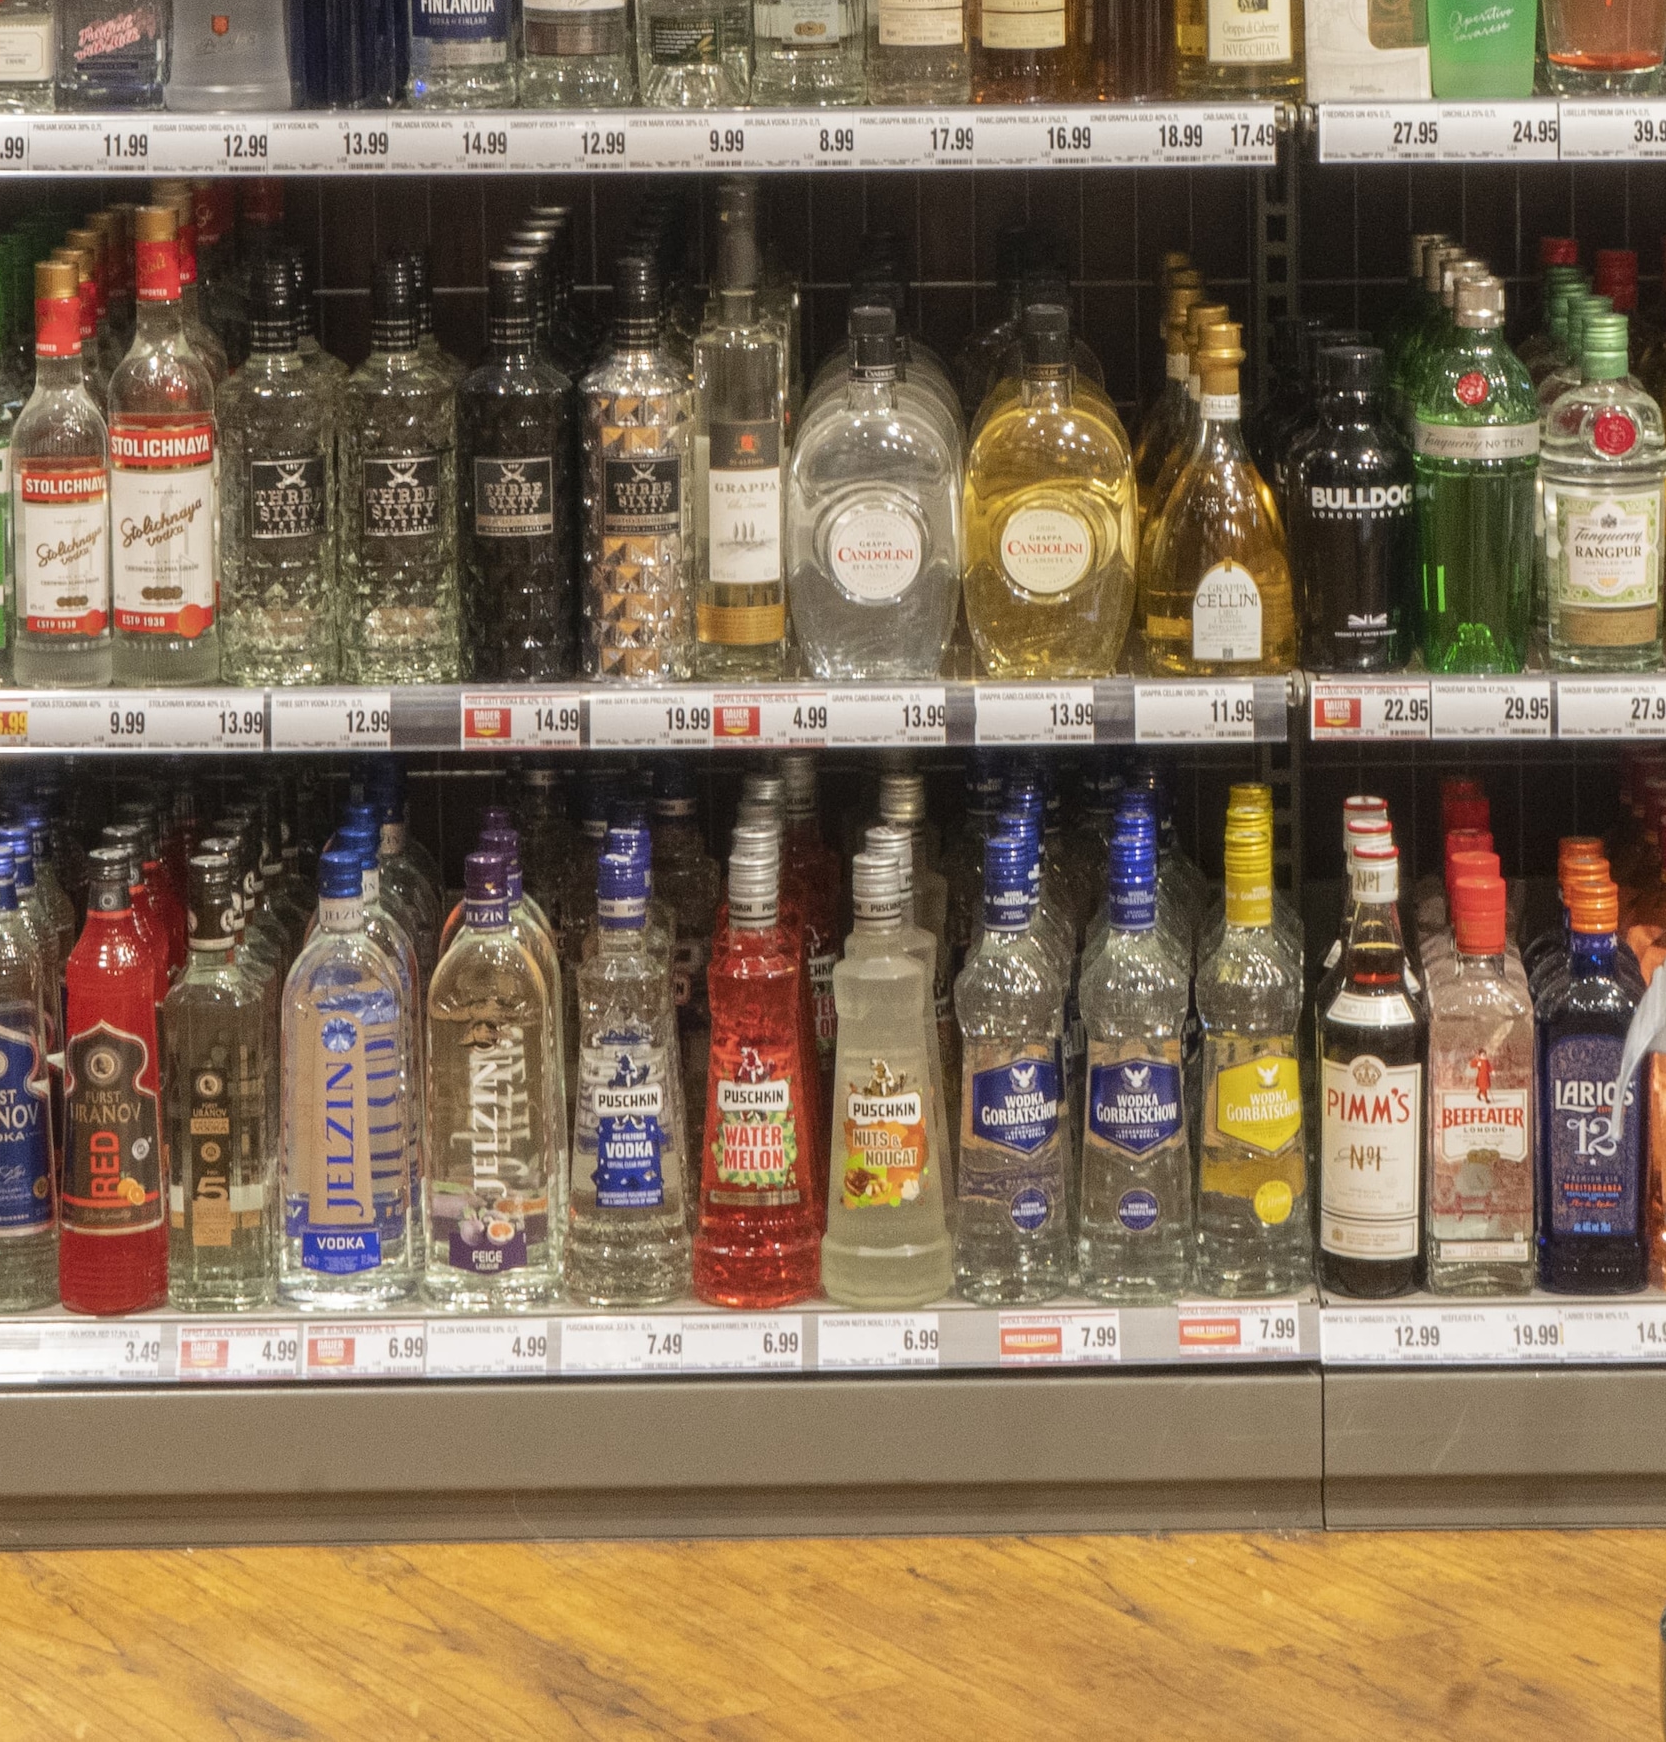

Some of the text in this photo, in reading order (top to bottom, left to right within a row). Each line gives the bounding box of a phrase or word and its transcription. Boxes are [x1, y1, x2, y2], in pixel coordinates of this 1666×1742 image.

[710, 130, 745, 152] 9.99
[1047, 127, 1091, 149] 16.99
[1513, 121, 1558, 143] 24.95
[343, 133, 388, 155] 13.99
[111, 433, 210, 457] STOLICHNAYA
[484, 481, 543, 498] THREE
[715, 481, 779, 494] GRAPPA
[1311, 486, 1413, 510] BULLDOG
[489, 497, 540, 511] SIXTY
[1312, 510, 1394, 518] LONDON DRY
[838, 547, 914, 563] CANDOLINI
[1007, 540, 1083, 556] CANDOLINI
[1575, 543, 1641, 558] RANGPUR
[1196, 594, 1259, 609] CELLINI
[345, 709, 390, 734] 12.99
[793, 707, 828, 729] 4.99
[1384, 700, 1429, 722] 22.95
[598, 1092, 658, 1108] PUSCHKIN
[723, 1088, 783, 1105] PUSCHKIN
[1116, 1092, 1158, 1106] WODKA
[1327, 1087, 1410, 1124] PIMM'S
[853, 1101, 915, 1118] PUSCHKIN
[1096, 1103, 1177, 1124] GORBATSCHOW
[1441, 1106, 1525, 1129] BEEFEATER
[326, 1062, 363, 1216] JELZIN
[724, 1125, 782, 1147] WATER
[1463, 1125, 1505, 1134] LONDON
[605, 1140, 653, 1158] VODKA
[723, 1147, 783, 1170] MELON
[865, 1149, 918, 1167] NOUGAT
[91, 1132, 118, 1198] RED
[317, 1237, 365, 1250] VODKA
[471, 1251, 502, 1263] FEIGE
[388, 1333, 423, 1357] 6.99
[647, 1332, 682, 1355] 7.49
[1080, 1326, 1116, 1349] 7.99
[1513, 1325, 1559, 1347] 19.99
